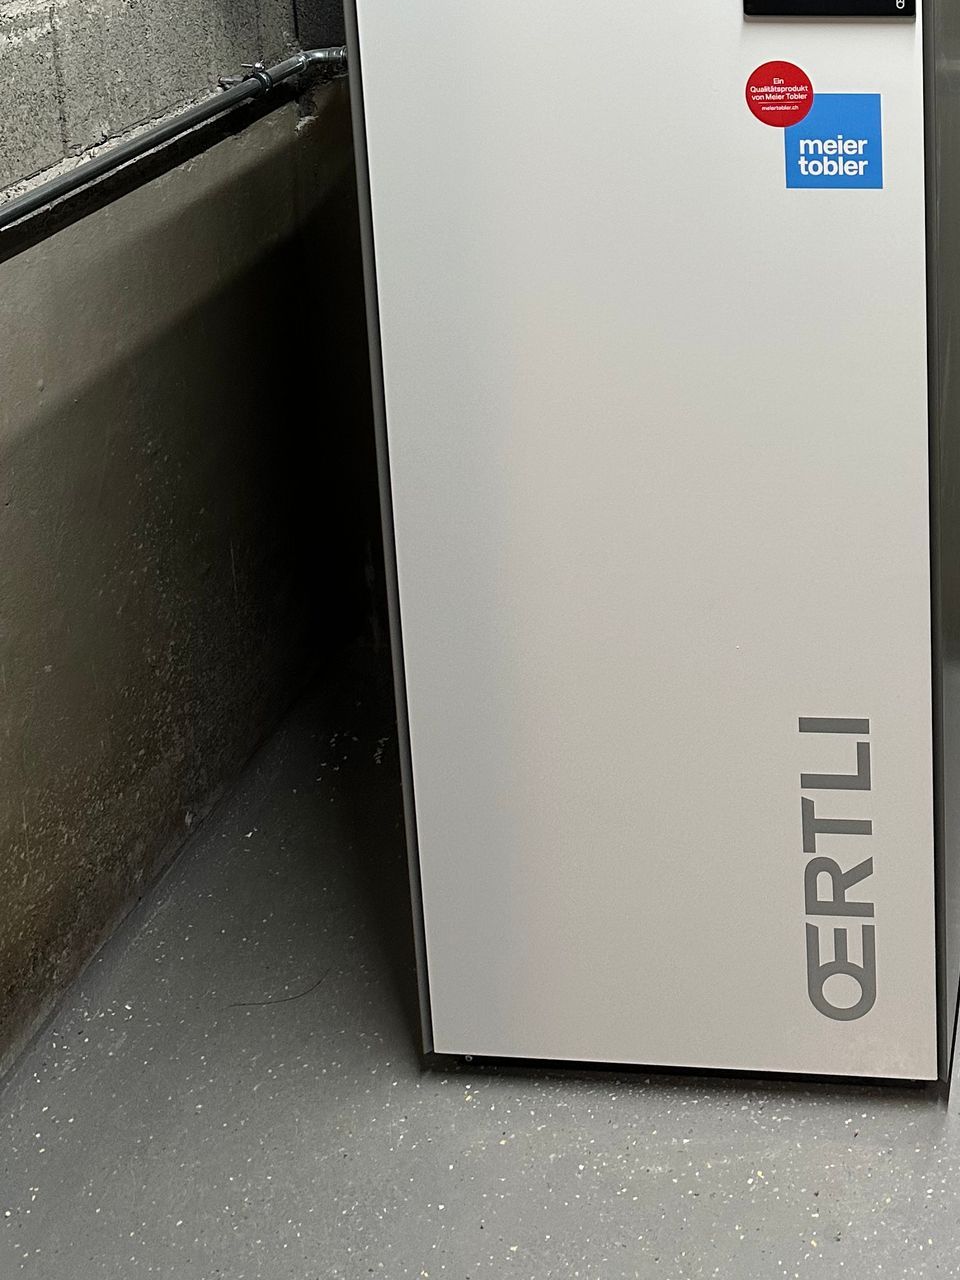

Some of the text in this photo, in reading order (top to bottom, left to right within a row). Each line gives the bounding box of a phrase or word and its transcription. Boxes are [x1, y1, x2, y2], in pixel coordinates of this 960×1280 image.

[773, 77, 785, 85] Ein
[750, 85, 809, 94] Qualitätsprodukt
[765, 93, 785, 101] Meier
[785, 92, 808, 100] Tobler
[799, 134, 868, 155] meier
[797, 156, 868, 176] tobler
